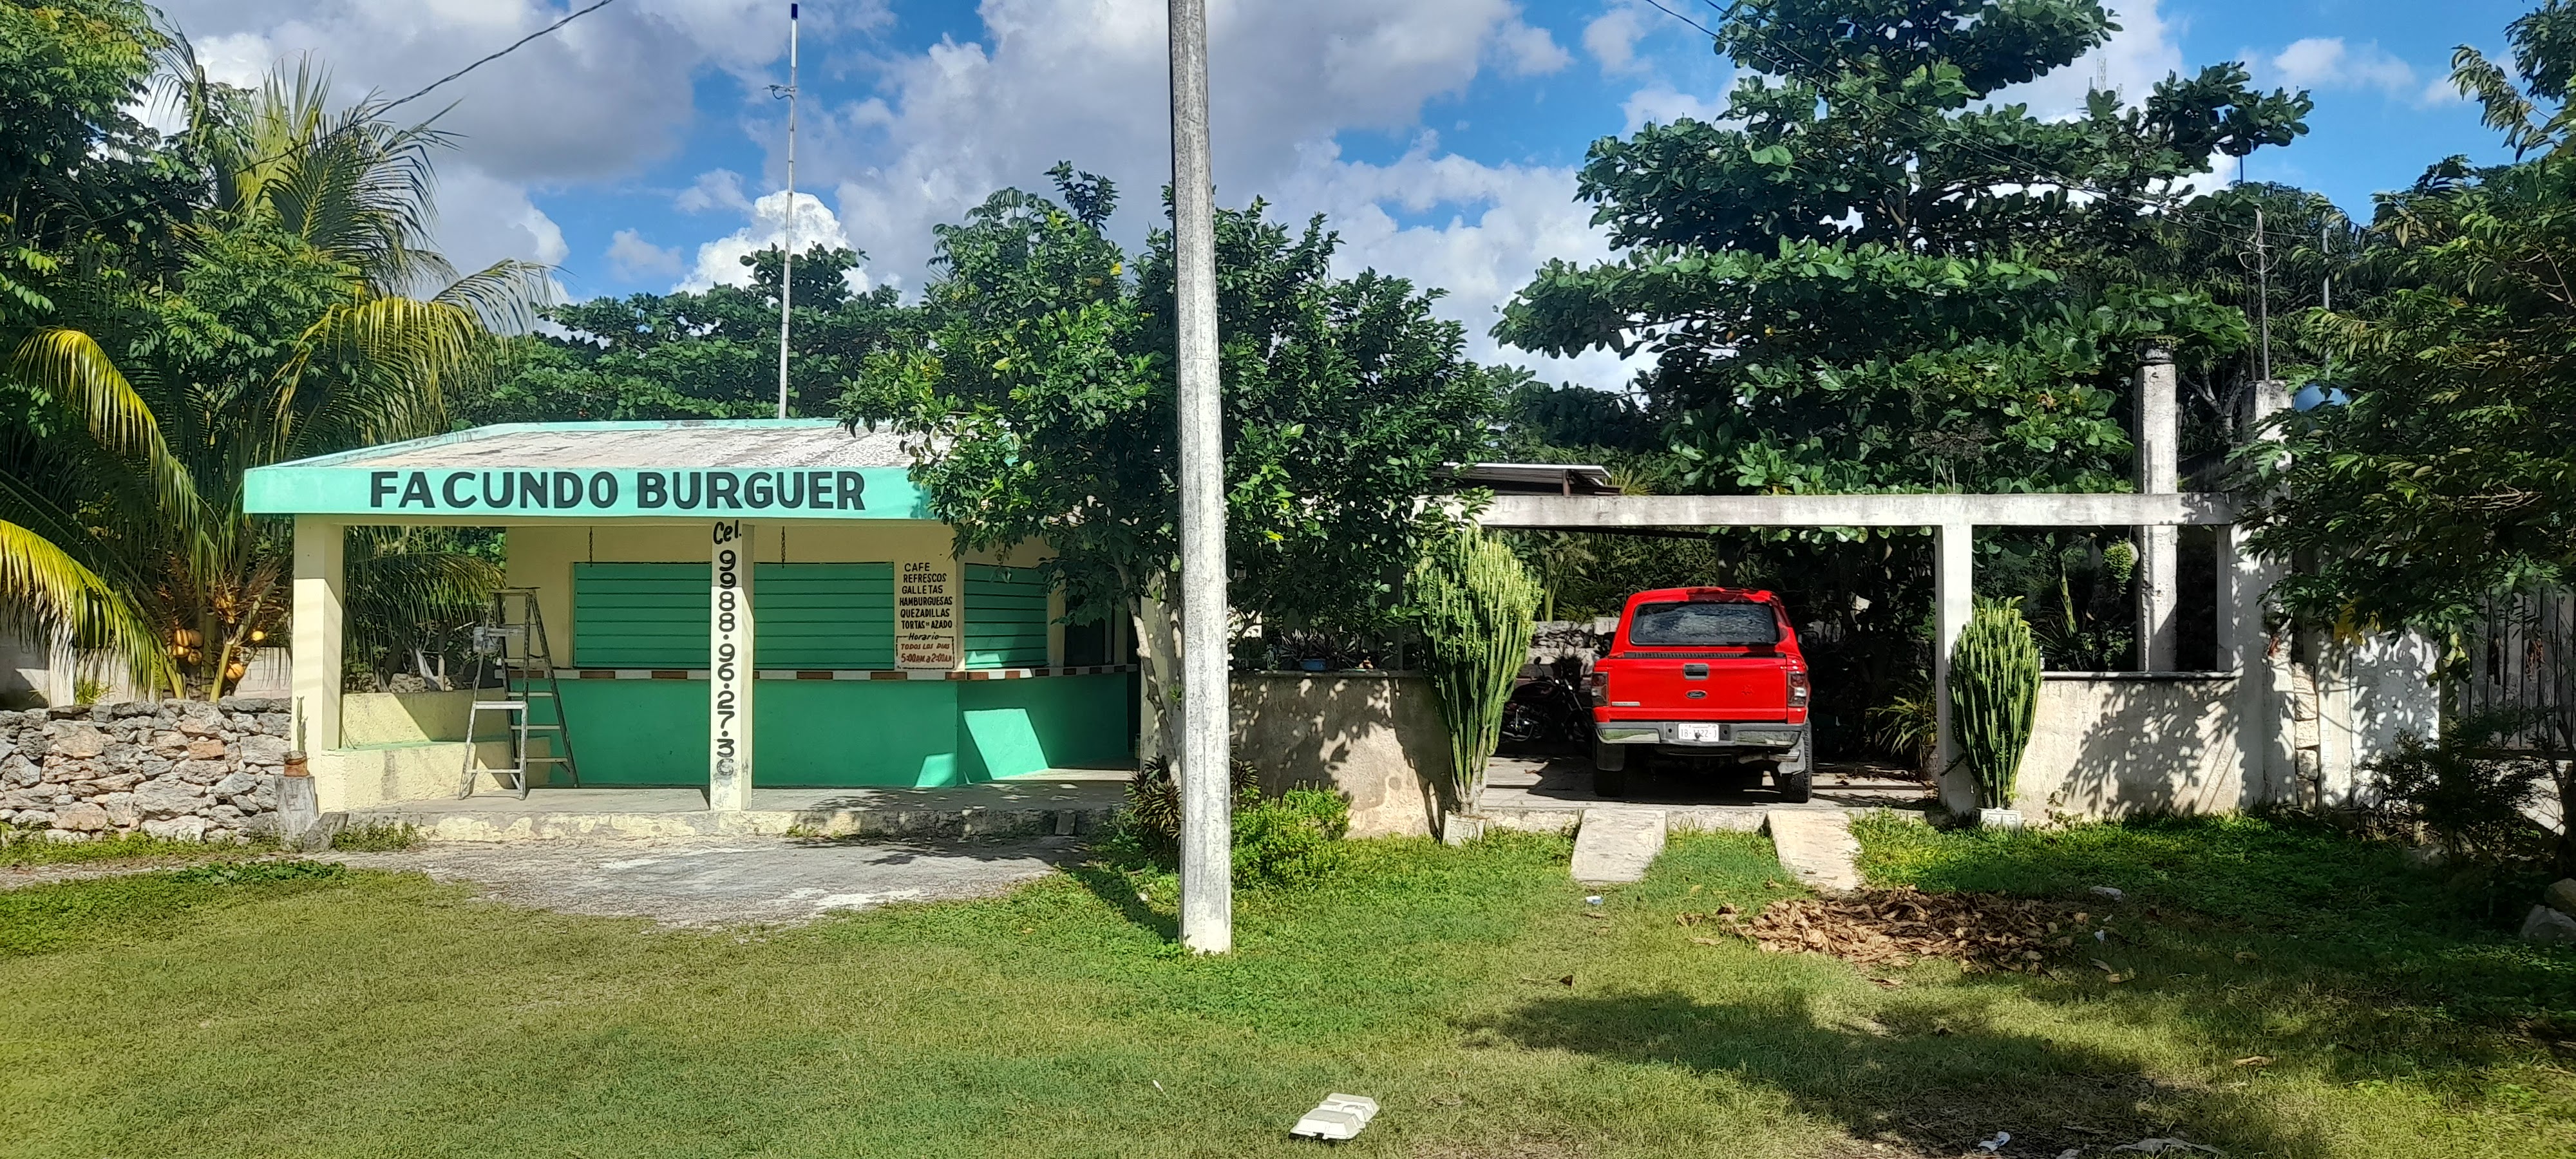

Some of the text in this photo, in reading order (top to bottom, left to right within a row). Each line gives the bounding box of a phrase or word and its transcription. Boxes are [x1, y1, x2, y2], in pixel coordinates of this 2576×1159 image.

[370, 471, 866, 511] FACUNDO BURGUER
[713, 520, 742, 545] Cel.
[904, 562, 931, 572] CAFE
[903, 573, 947, 583] REFRESCOS
[902, 585, 943, 594] GALLETAS
[899, 596, 953, 607] HAMBURGUESAS
[900, 608, 951, 618] QUEZADILLAS
[901, 620, 925, 630] TORTAS
[931, 620, 952, 629] AZADO
[908, 632, 940, 641] Horario
